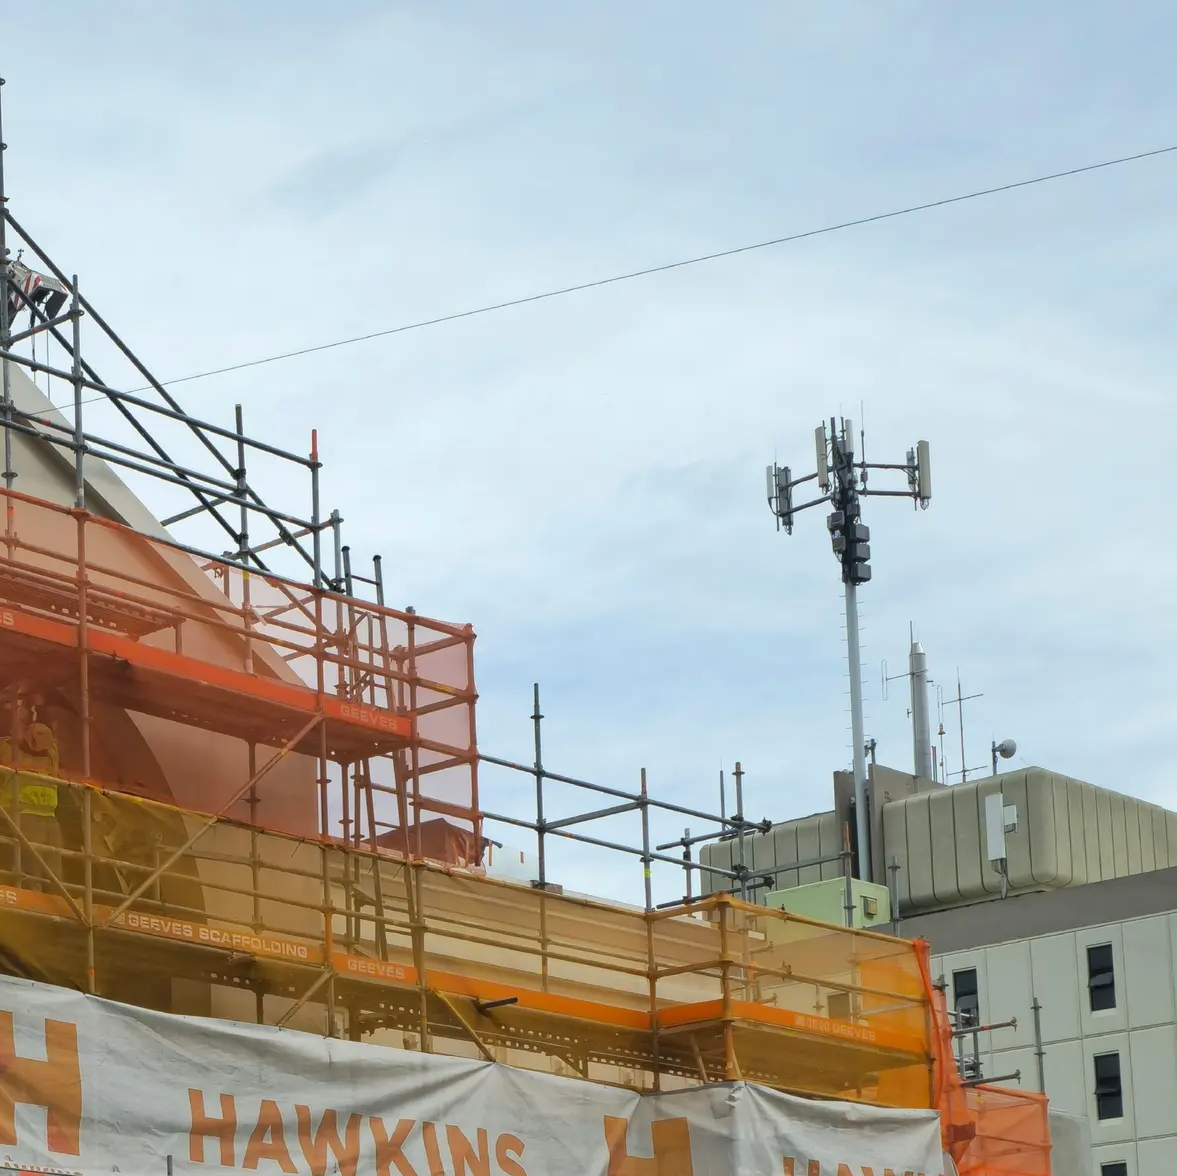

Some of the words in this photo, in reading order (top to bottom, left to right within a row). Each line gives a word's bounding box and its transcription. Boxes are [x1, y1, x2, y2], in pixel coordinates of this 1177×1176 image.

[340, 704, 398, 731] GEEVES
[127, 913, 193, 937] GEEVES
[199, 927, 308, 959] SCAFFOLDING
[347, 958, 406, 980] GEEVES
